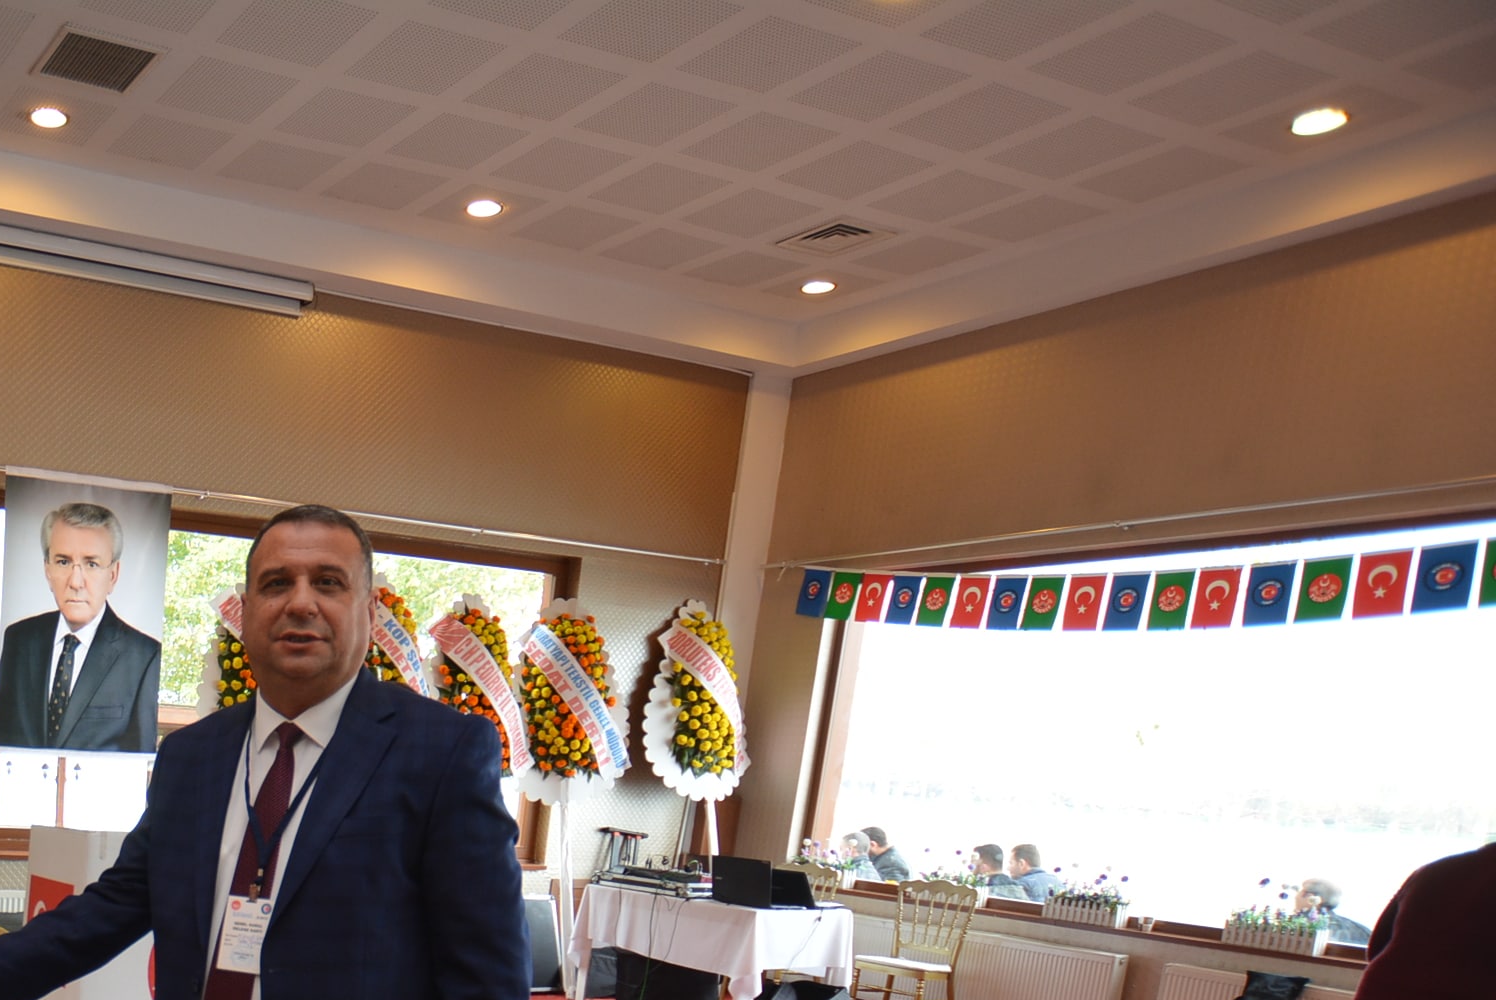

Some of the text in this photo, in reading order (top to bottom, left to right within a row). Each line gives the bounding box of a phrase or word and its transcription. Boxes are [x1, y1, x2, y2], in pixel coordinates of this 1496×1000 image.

[373, 624, 413, 673] HMET
[383, 618, 410, 648] KOP
[666, 629, 722, 683] ZORLUTEKS
[525, 641, 573, 694] SEDAT
[564, 663, 595, 703] TEKSTİL
